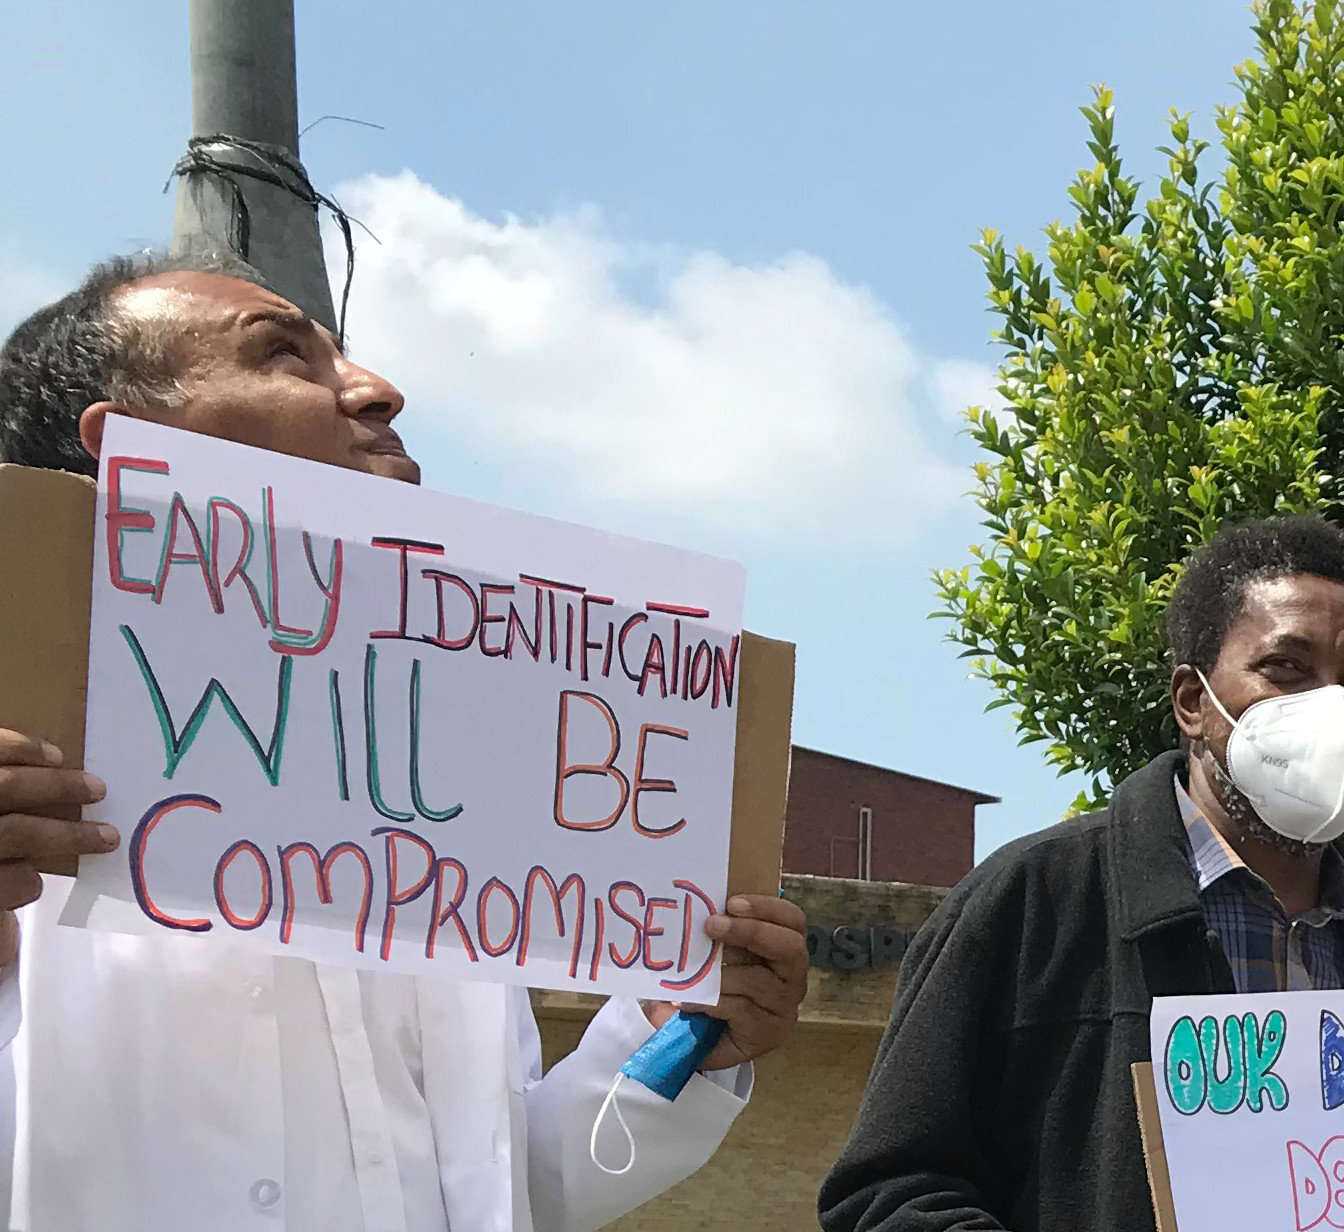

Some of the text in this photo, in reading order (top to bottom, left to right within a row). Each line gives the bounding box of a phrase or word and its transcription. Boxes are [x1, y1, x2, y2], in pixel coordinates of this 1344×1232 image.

[107, 456, 740, 709] EARLY IDENTIFICATION
[118, 623, 690, 838] WILL BE
[129, 793, 722, 990] COMPROMISED
[1163, 1009, 1290, 1116] OUR
